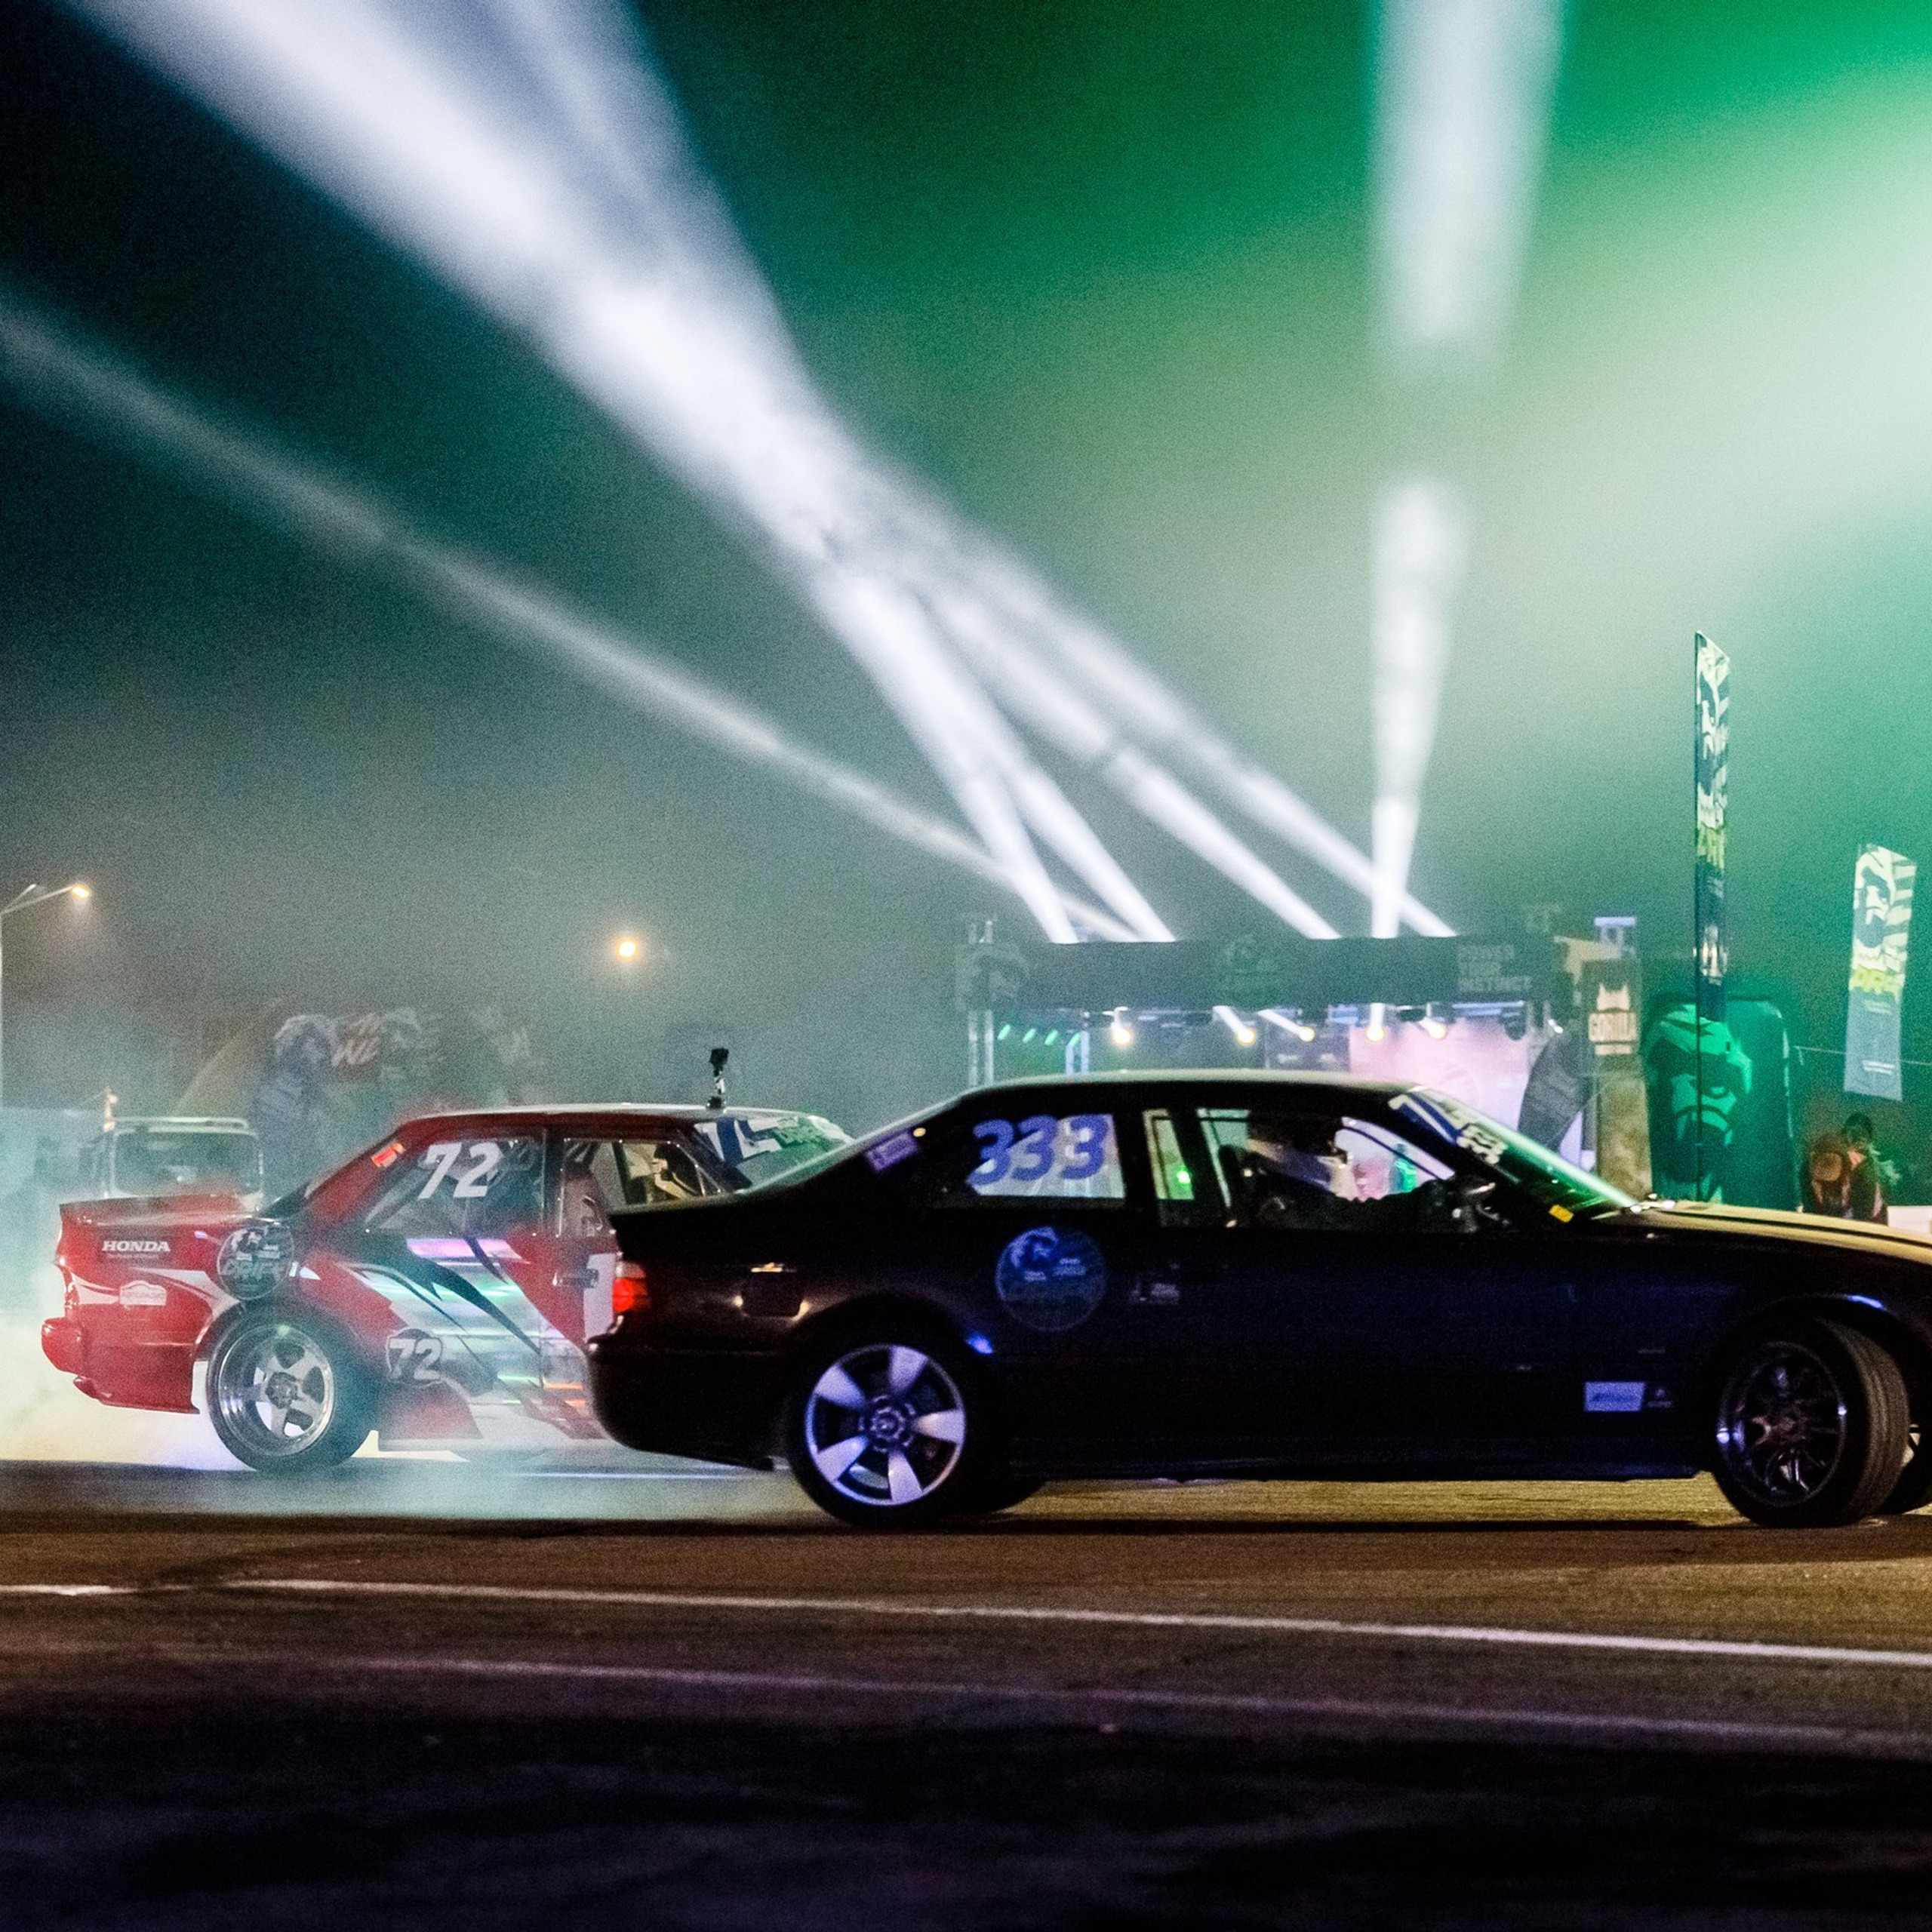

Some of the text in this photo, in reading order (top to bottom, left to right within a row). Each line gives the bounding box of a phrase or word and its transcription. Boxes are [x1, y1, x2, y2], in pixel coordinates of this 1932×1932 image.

[417, 1141, 503, 1200] 72
[967, 1114, 1108, 1185] 333
[101, 1240, 171, 1252] HONDA
[389, 1338, 442, 1381] 72
